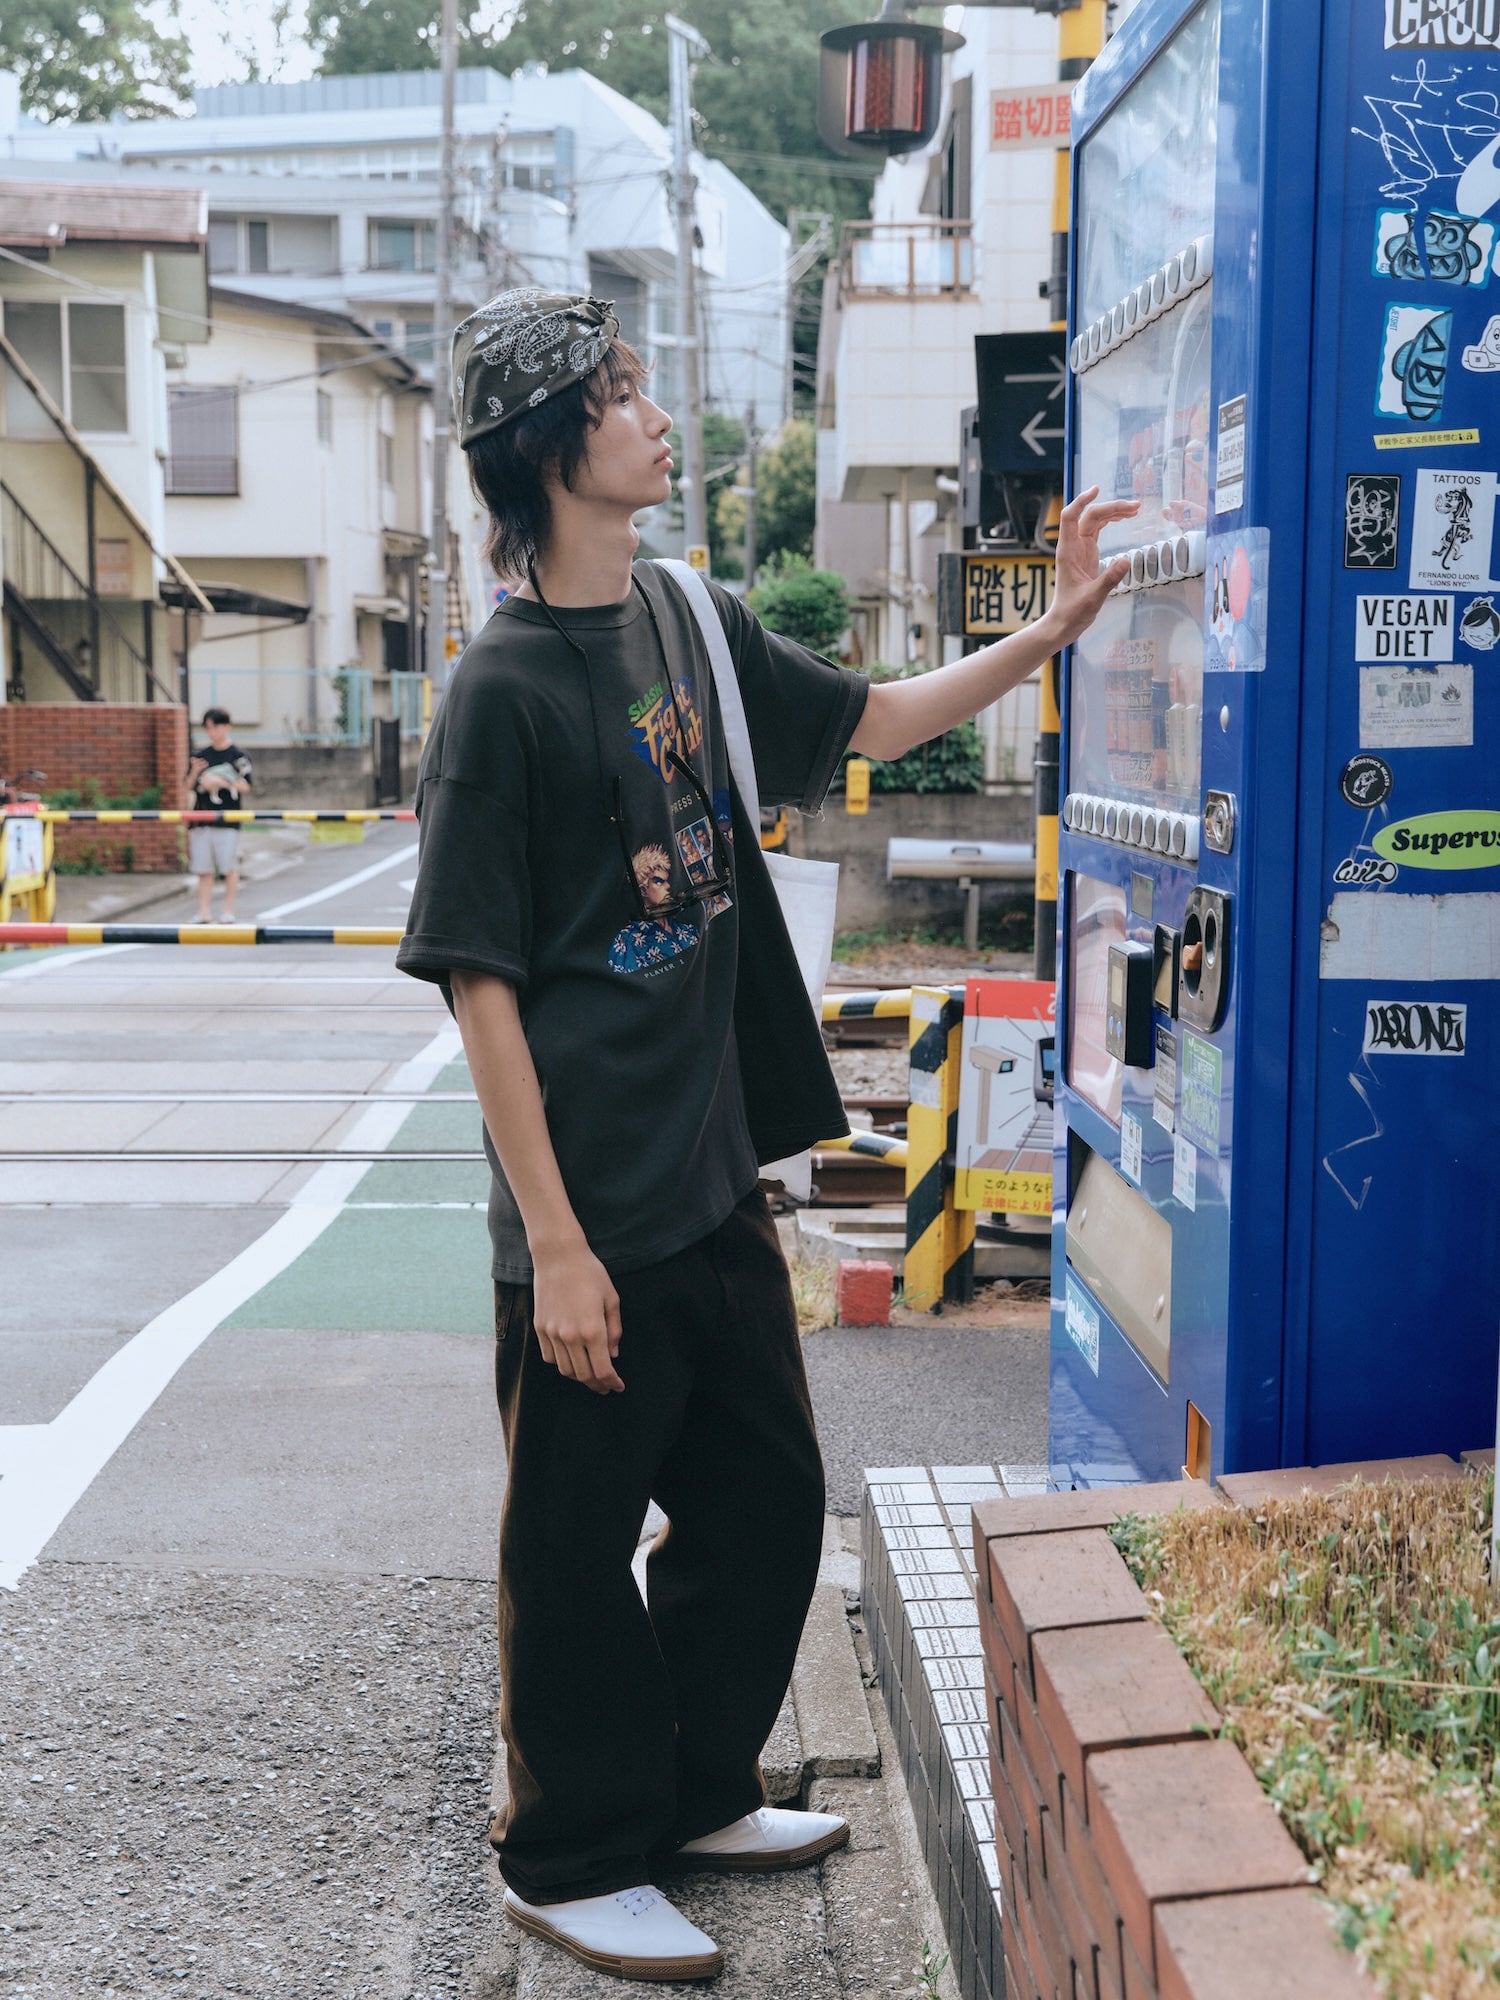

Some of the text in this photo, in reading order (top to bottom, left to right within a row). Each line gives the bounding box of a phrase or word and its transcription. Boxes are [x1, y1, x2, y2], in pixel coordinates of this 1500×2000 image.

[1432, 474, 1481, 485] TATTOOS
[1418, 571, 1480, 581] FERNANDO LIONS
[969, 564, 1056, 623] 踏切
[1362, 599, 1448, 626] VEGAN
[1376, 630, 1434, 657] DIET
[628, 681, 663, 722] SLASH
[634, 680, 693, 767] Fight
[660, 707, 702, 784] Club
[644, 962, 676, 979] PLAYER
